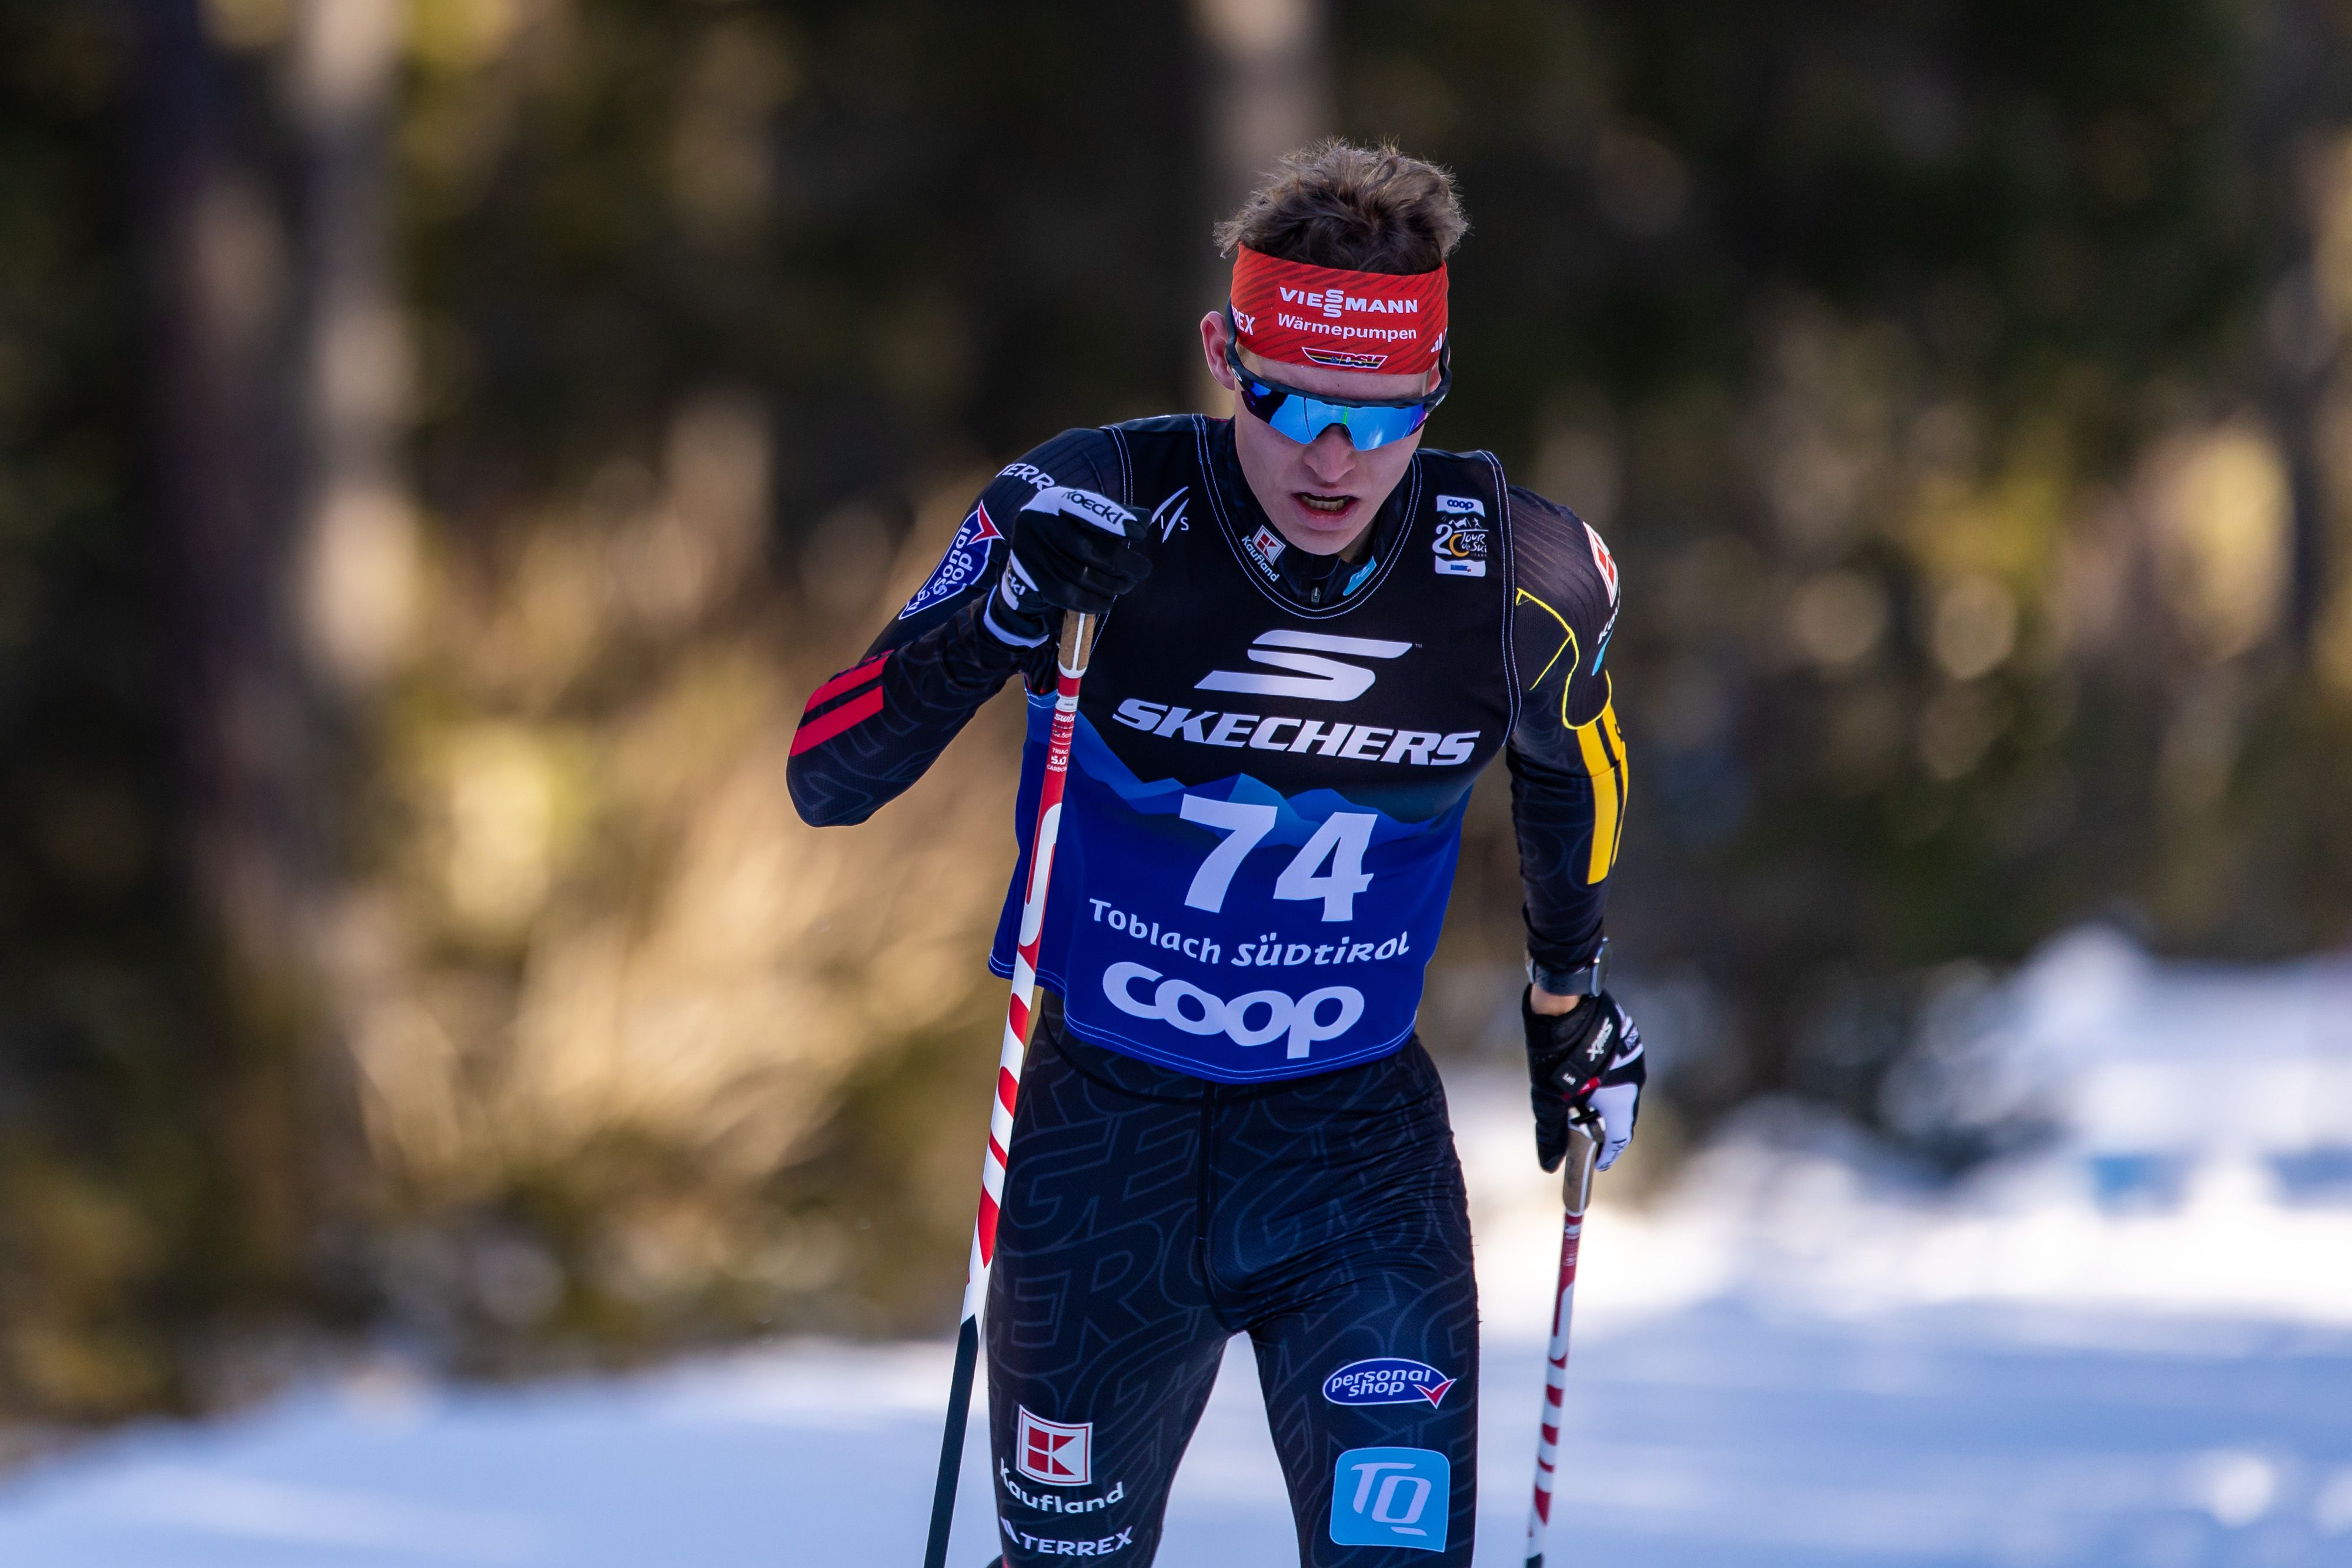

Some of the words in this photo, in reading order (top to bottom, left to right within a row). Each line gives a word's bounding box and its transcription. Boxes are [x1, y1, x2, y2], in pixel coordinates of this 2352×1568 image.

[1279, 287, 1418, 317] VIESSMANN
[1231, 304, 1255, 336] REX
[1278, 313, 1417, 342] Wärmepumpen
[995, 463, 1055, 492] TERR
[1447, 499, 1474, 510] coop
[1241, 536, 1279, 582] Kaufland
[1112, 698, 1481, 765] SKECHERS
[1051, 755, 1067, 765] 5.0
[1180, 794, 1378, 922] 74
[1089, 898, 1221, 964] Toblach
[1103, 962, 1364, 1059] coop
[1331, 1369, 1431, 1392] personal
[1348, 1380, 1405, 1396] shop
[1000, 1457, 1124, 1513] Kaufland
[1351, 1462, 1432, 1536] TQ
[1020, 1526, 1132, 1556] TERREX
